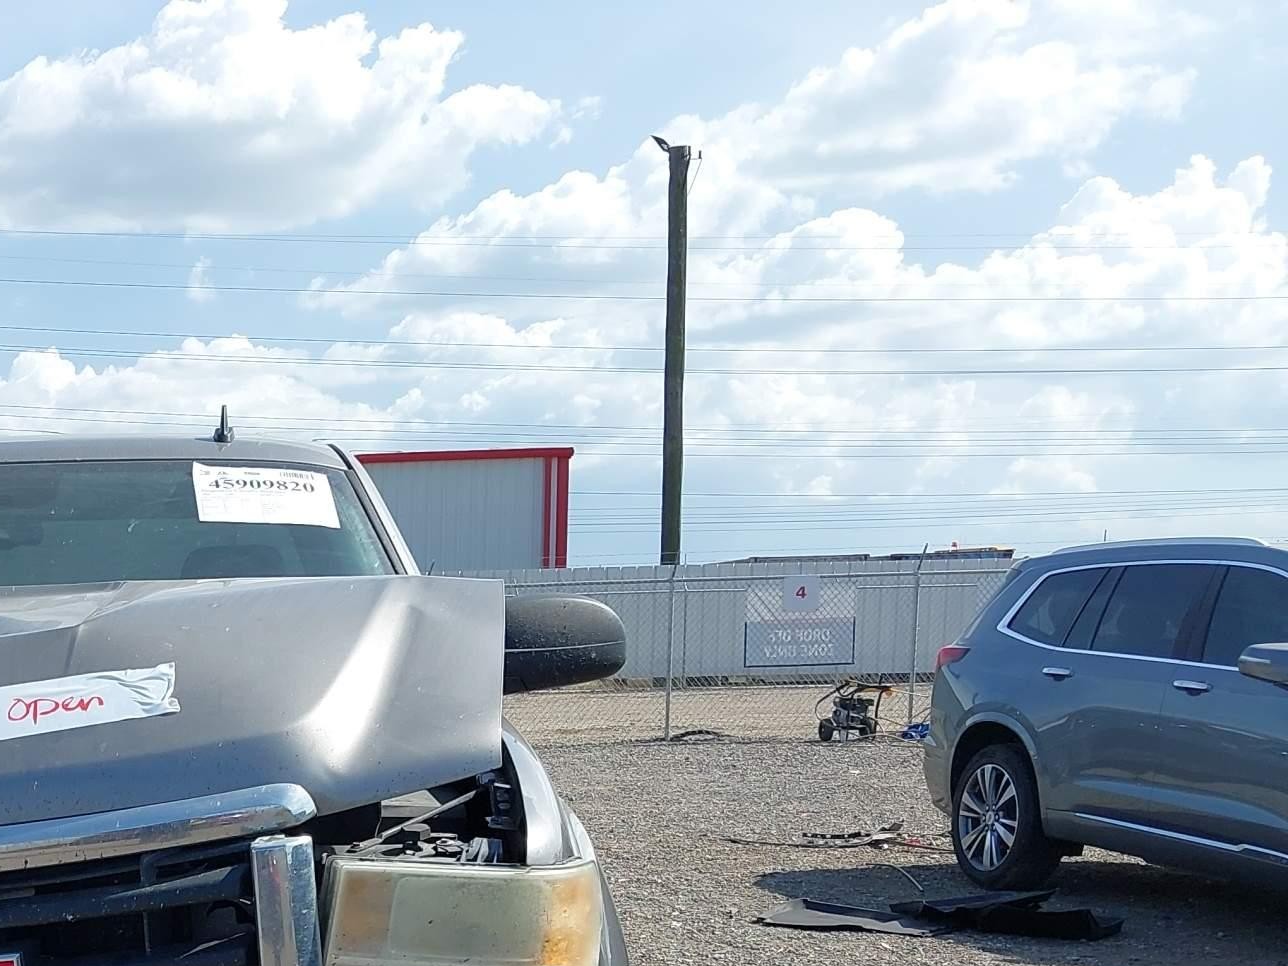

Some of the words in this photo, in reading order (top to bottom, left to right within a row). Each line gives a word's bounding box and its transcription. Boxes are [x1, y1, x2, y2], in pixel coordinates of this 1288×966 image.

[209, 478, 315, 493] 45909820
[795, 586, 807, 599] 4
[8, 696, 104, 725] open
